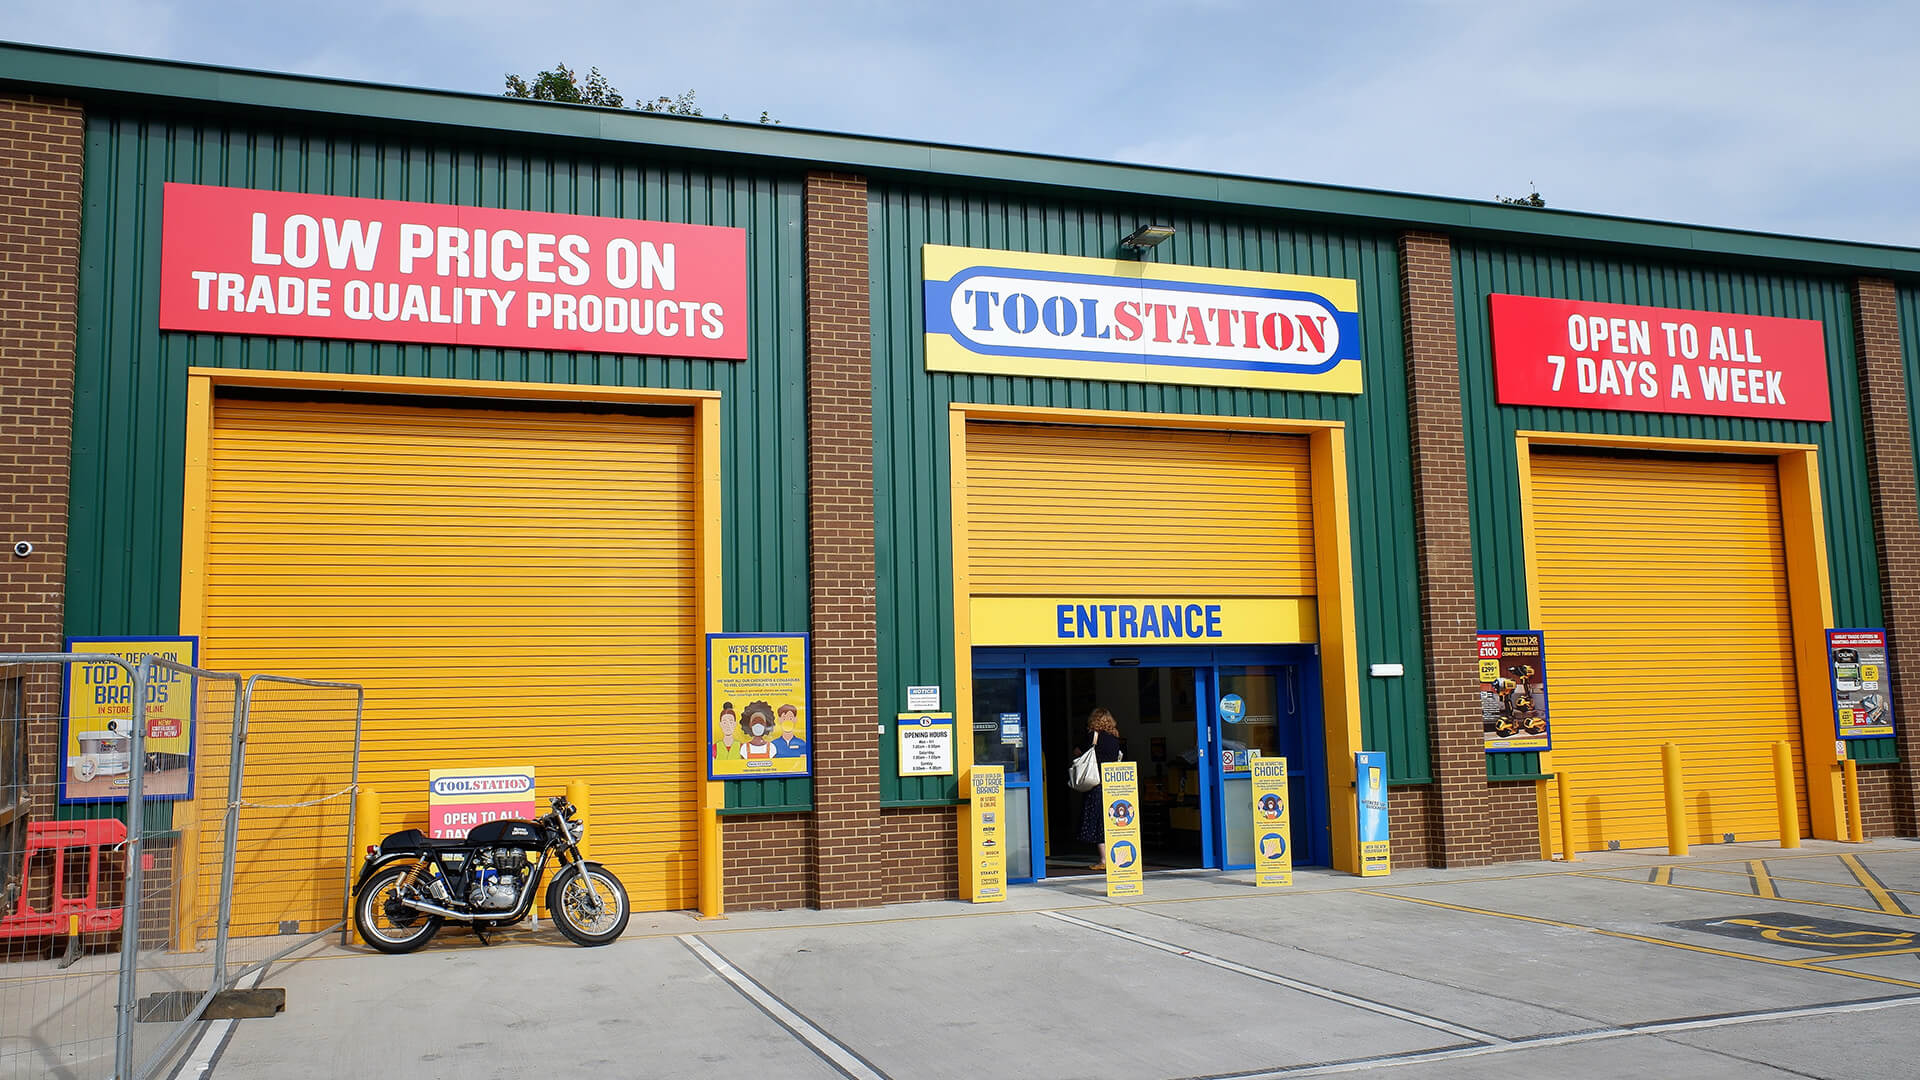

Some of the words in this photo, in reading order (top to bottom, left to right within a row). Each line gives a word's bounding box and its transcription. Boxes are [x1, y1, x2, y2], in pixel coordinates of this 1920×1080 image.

[251, 212, 382, 272] LOW
[400, 222, 591, 287] PRICES
[606, 238, 676, 291] ON
[191, 270, 331, 318] TRADE
[343, 279, 514, 328] QUALITY
[527, 291, 725, 341] PRODUCTS
[965, 289, 1329, 354] TOOLSTATION
[1567, 313, 1651, 356] OPEN
[1660, 321, 1699, 360] TO
[1708, 326, 1762, 363] ALL
[1547, 355, 1566, 392] 7
[1576, 356, 1659, 399] DAYS
[1670, 364, 1692, 400] A
[1698, 365, 1787, 406] WEEK
[1057, 603, 1223, 639] ENTRANCE
[728, 645, 749, 653] WE'RE
[750, 645, 788, 653] RESPECTING
[1480, 648, 1498, 657] £100
[728, 654, 789, 674] CHOICE
[82, 665, 118, 684] TOP
[95, 685, 168, 704] BRADS
[98, 706, 106, 714] IN
[107, 706, 131, 714] STORE
[1104, 771, 1135, 782] CHOICE
[1254, 766, 1284, 777] CHOICE
[438, 779, 527, 792] TOOLSTATION
[972, 779, 984, 787] TOP
[985, 778, 1003, 786] TRADE
[976, 786, 1000, 794] BRANDS
[443, 812, 477, 825] OPEN
[480, 811, 496, 822] TO
[446, 828, 469, 839] DAY
